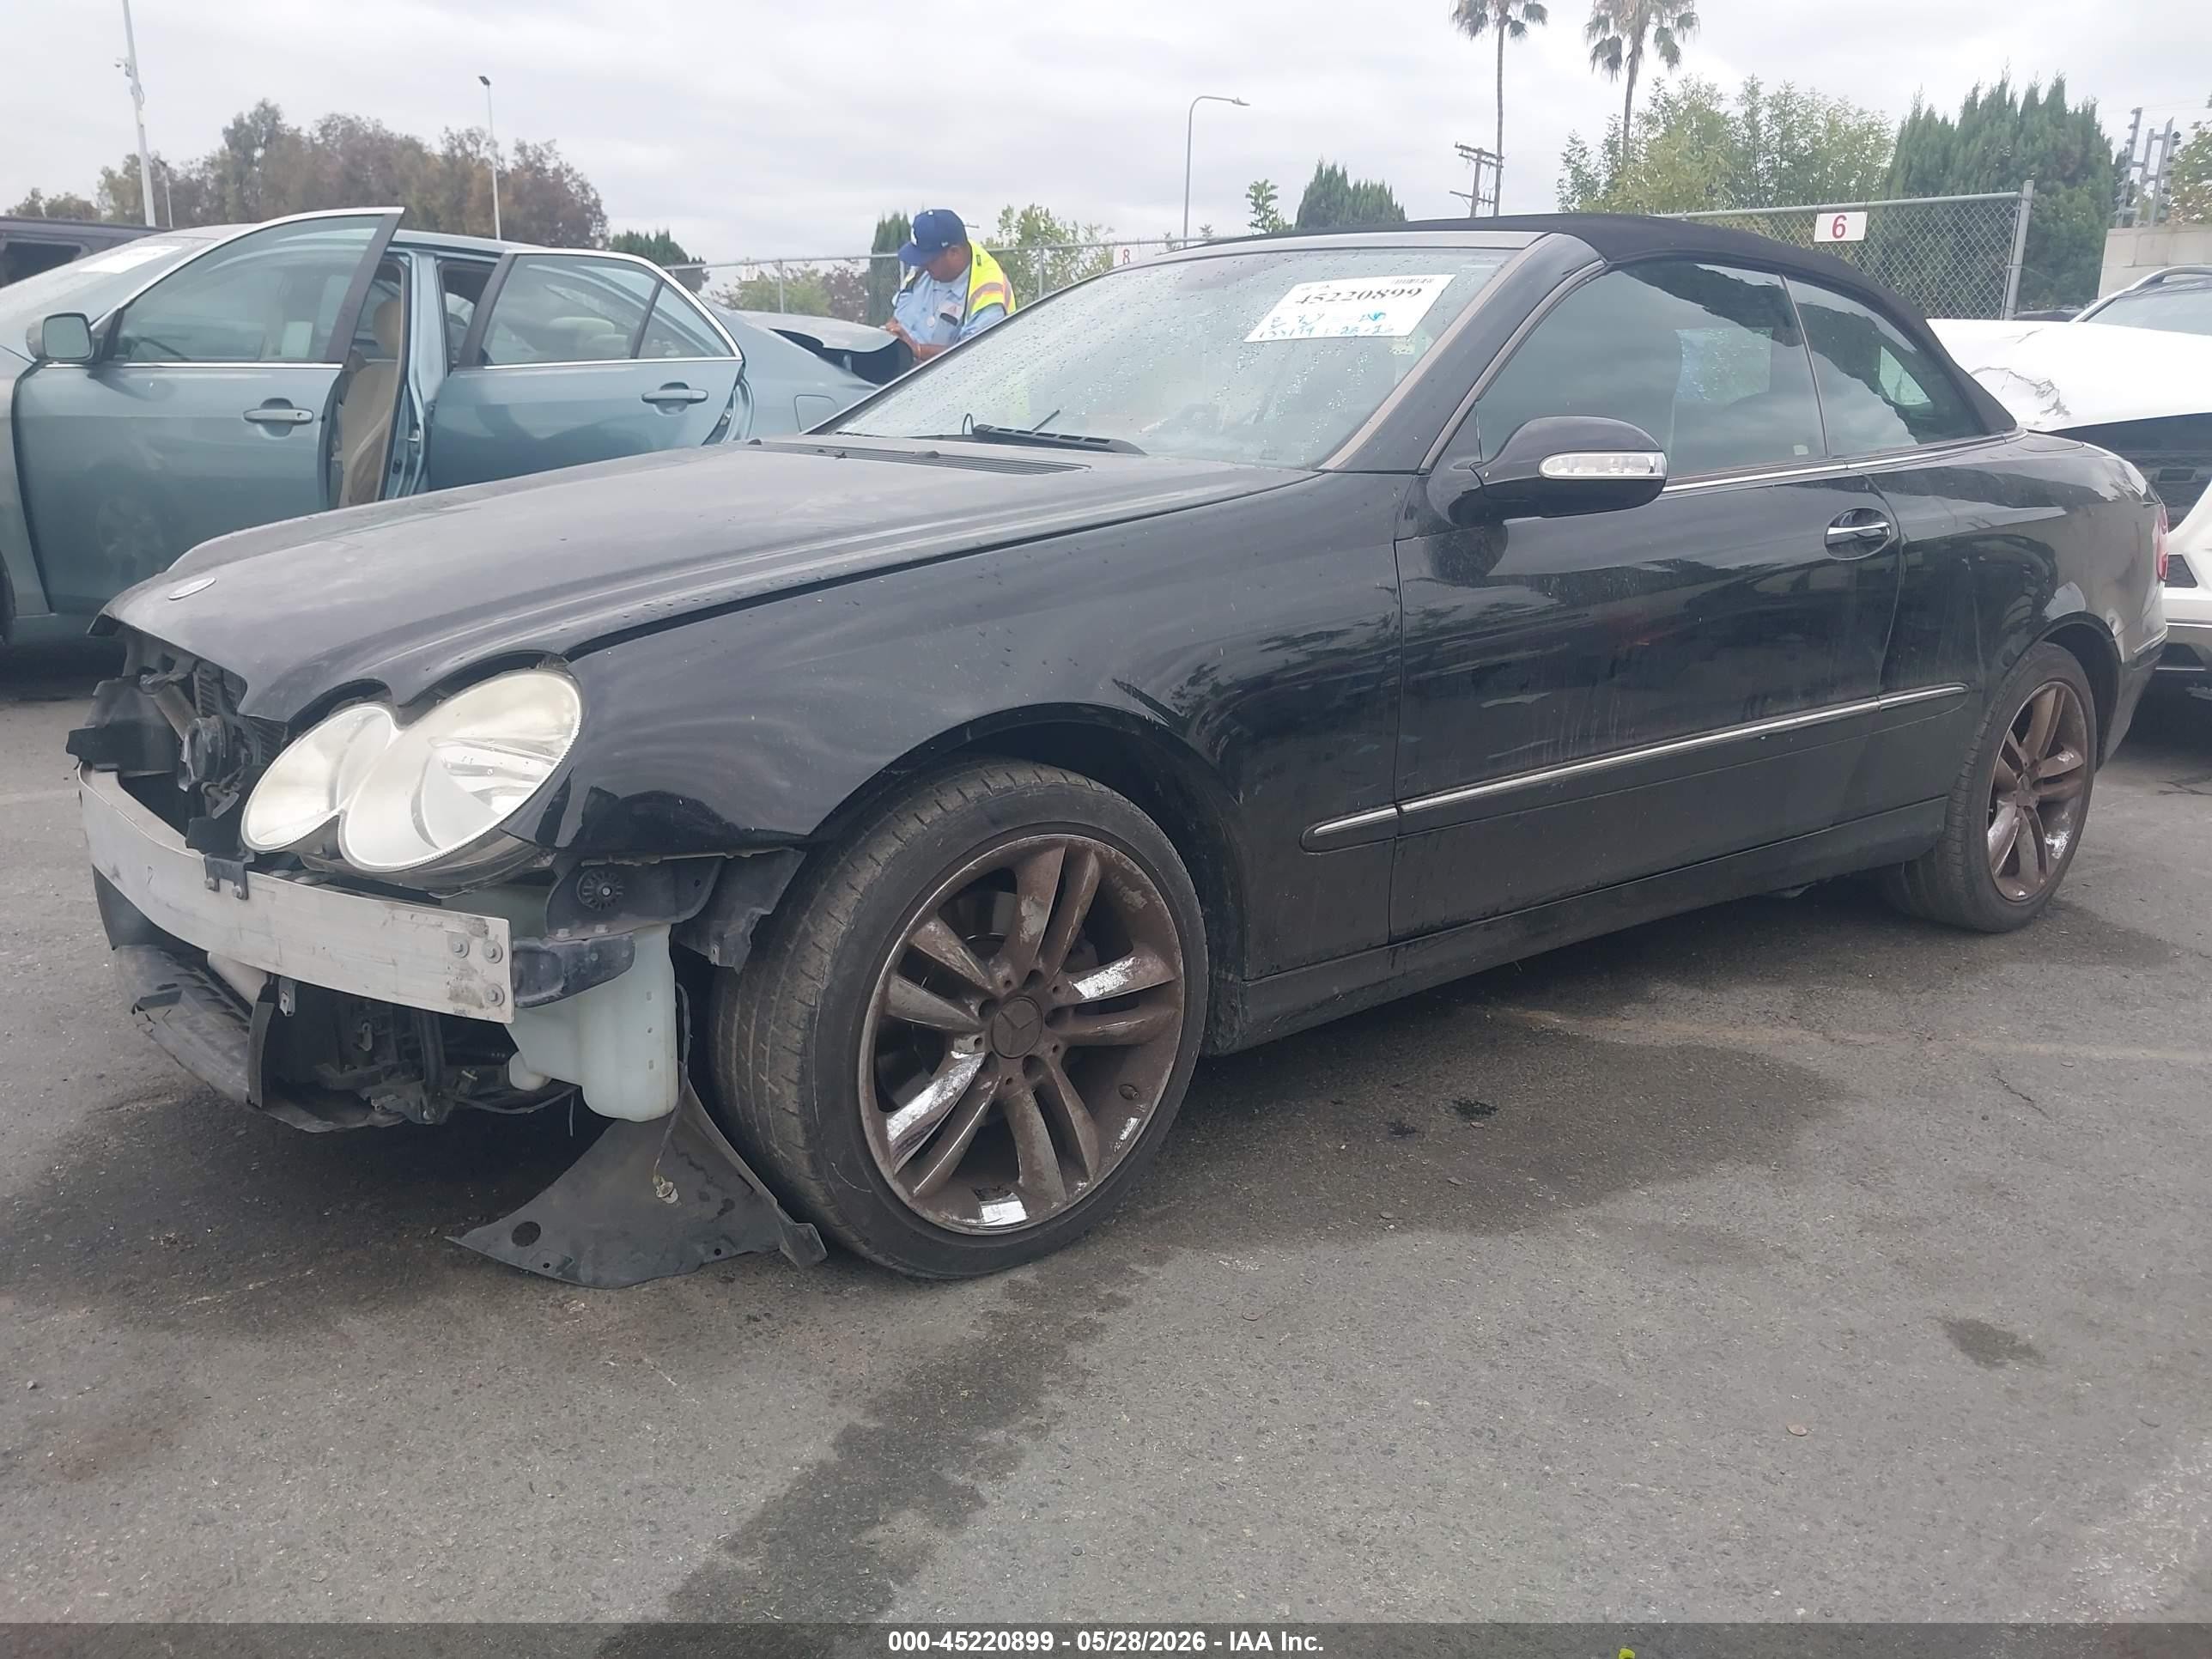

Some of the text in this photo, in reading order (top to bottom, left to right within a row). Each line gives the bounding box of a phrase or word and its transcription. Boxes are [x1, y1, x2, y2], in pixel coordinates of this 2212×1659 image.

[1832, 215, 1847, 240] 6
[1122, 248, 1130, 264] 8
[1295, 287, 1423, 304] 45220899
